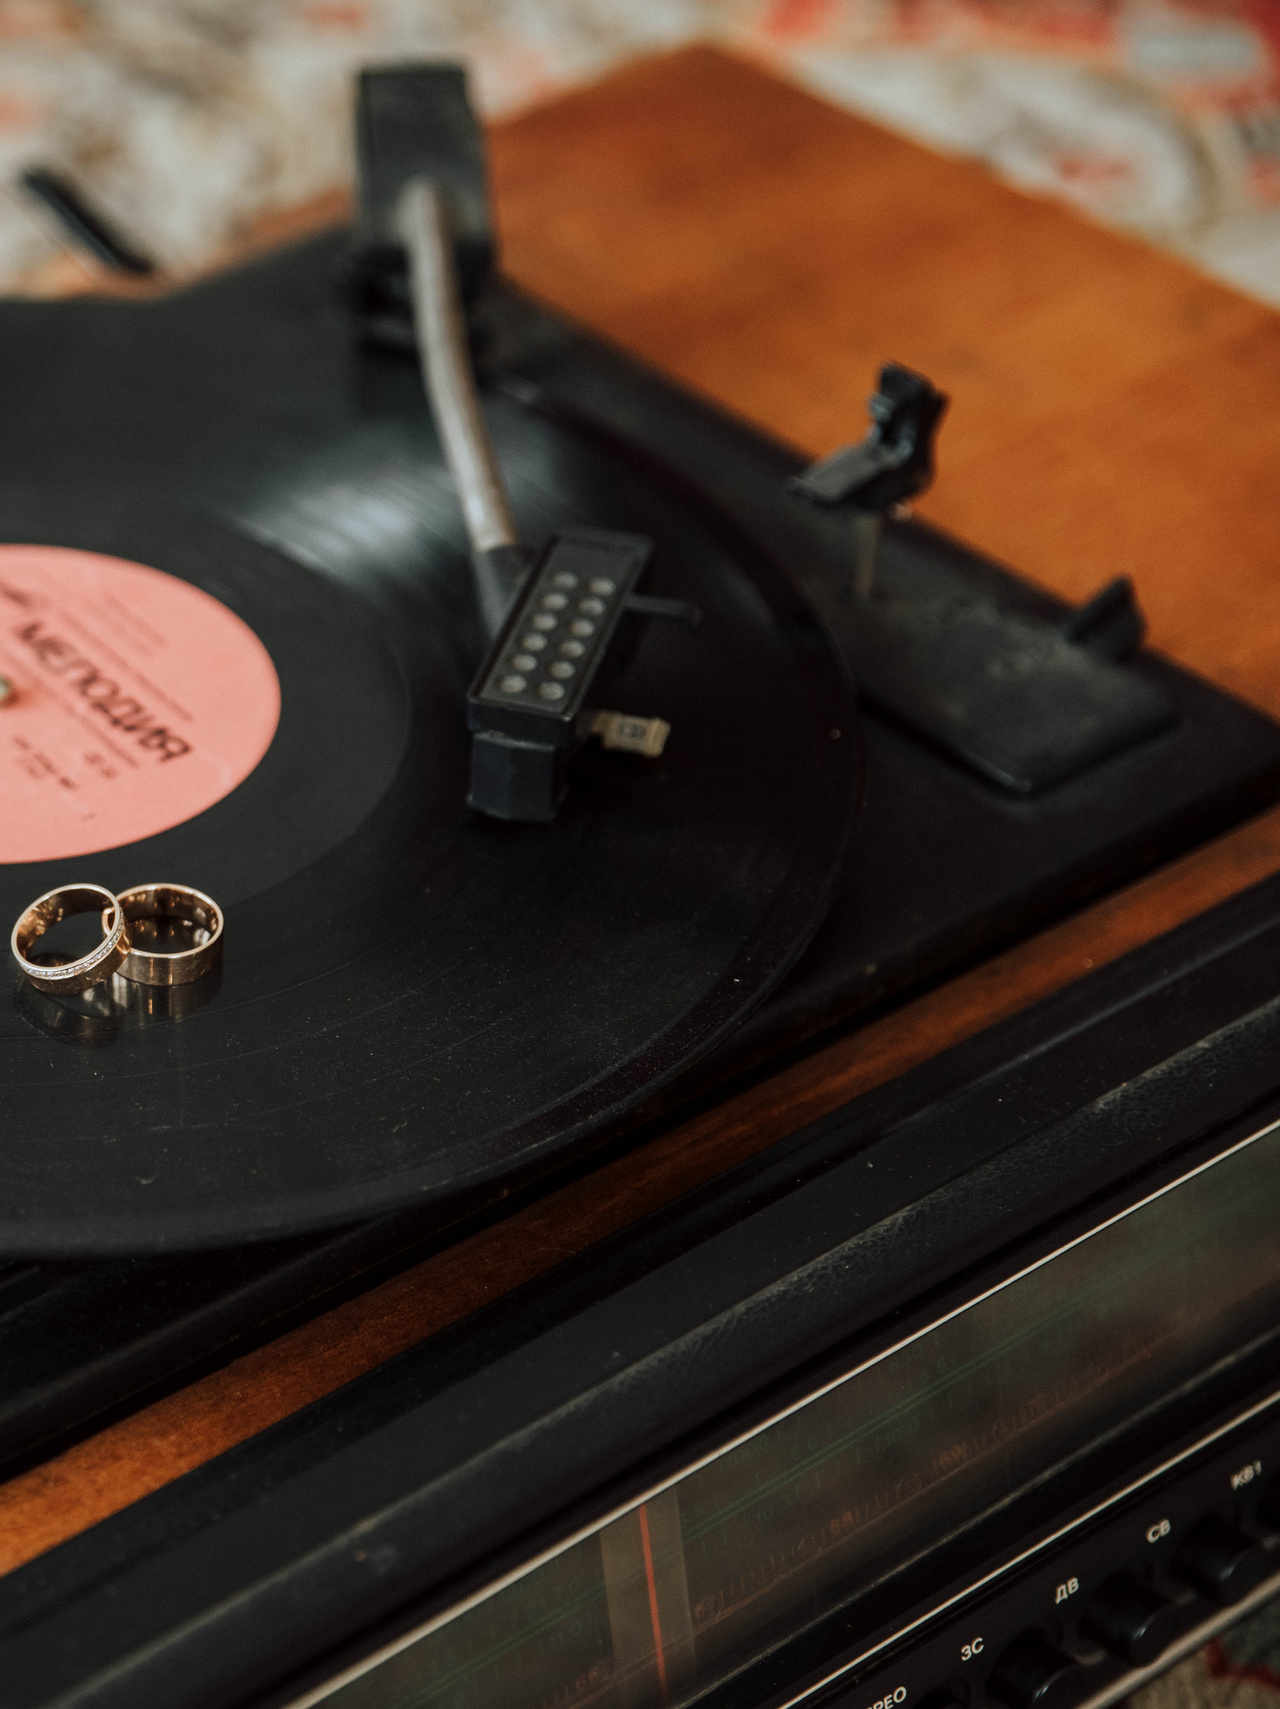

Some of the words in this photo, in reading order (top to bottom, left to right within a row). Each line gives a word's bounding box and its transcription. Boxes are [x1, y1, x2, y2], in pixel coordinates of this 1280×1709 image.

[1231, 1460, 1263, 1490] КВ1
[1146, 1518, 1172, 1543] СВ
[1055, 1577, 1080, 1604] ДВ
[866, 1686, 907, 1709] РЕО
